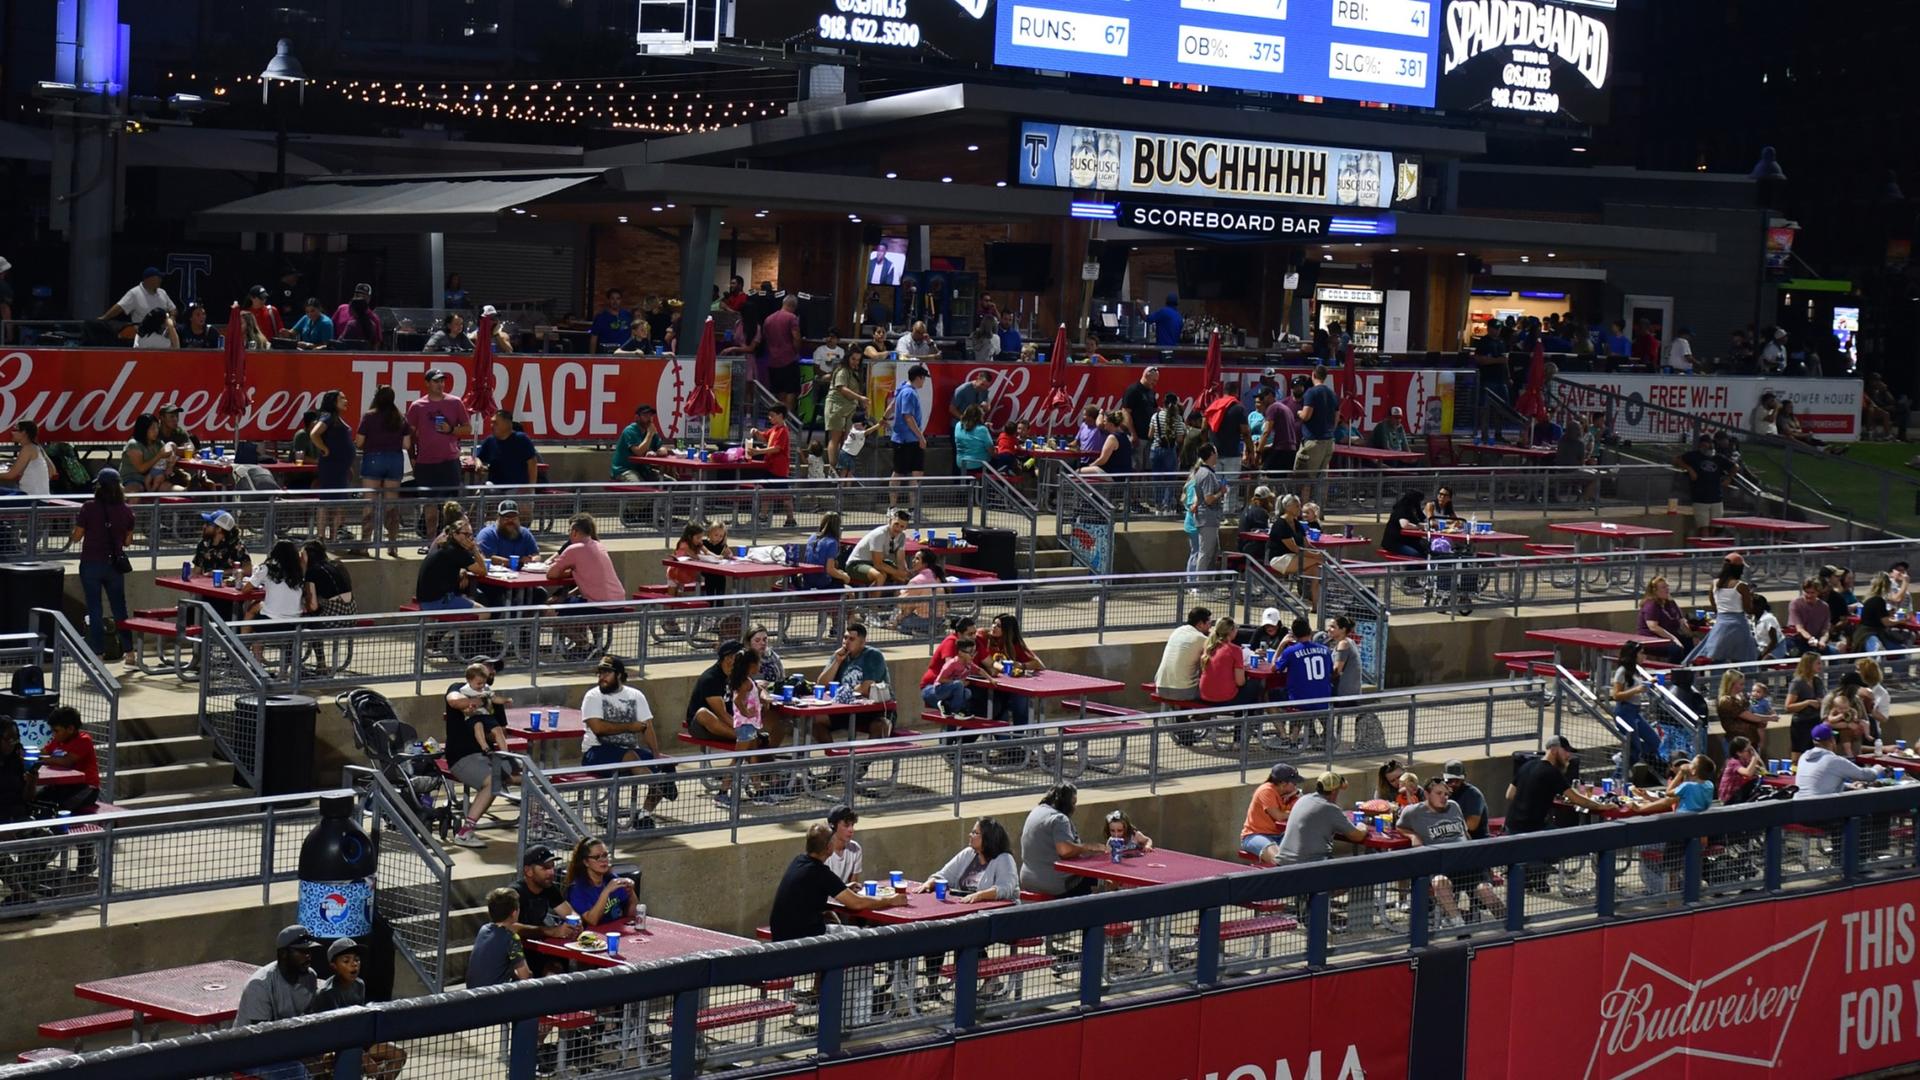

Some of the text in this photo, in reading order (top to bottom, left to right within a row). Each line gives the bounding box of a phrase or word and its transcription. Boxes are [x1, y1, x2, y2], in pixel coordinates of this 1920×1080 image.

[1338, 2, 1426, 28] RBI: 41
[819, 14, 919, 47] 918.622.5500
[1019, 16, 1126, 45] RUNS: 67
[1184, 35, 1281, 62] OB%: .375
[1335, 52, 1423, 78] SLG%: .381
[1133, 137, 1327, 198] BUSCHHHHH
[1133, 208, 1320, 234] SCOREBOARD BAR
[1559, 384, 1621, 407] SAVE ON
[1650, 385, 1728, 408] FREE WI-FI
[1824, 392, 1856, 405] HOURS
[1303, 655, 1325, 681] 10
[1841, 901, 1916, 975] THIS
[1601, 976, 1800, 1056] Budweiser
[1838, 983, 1903, 1055] FOR
